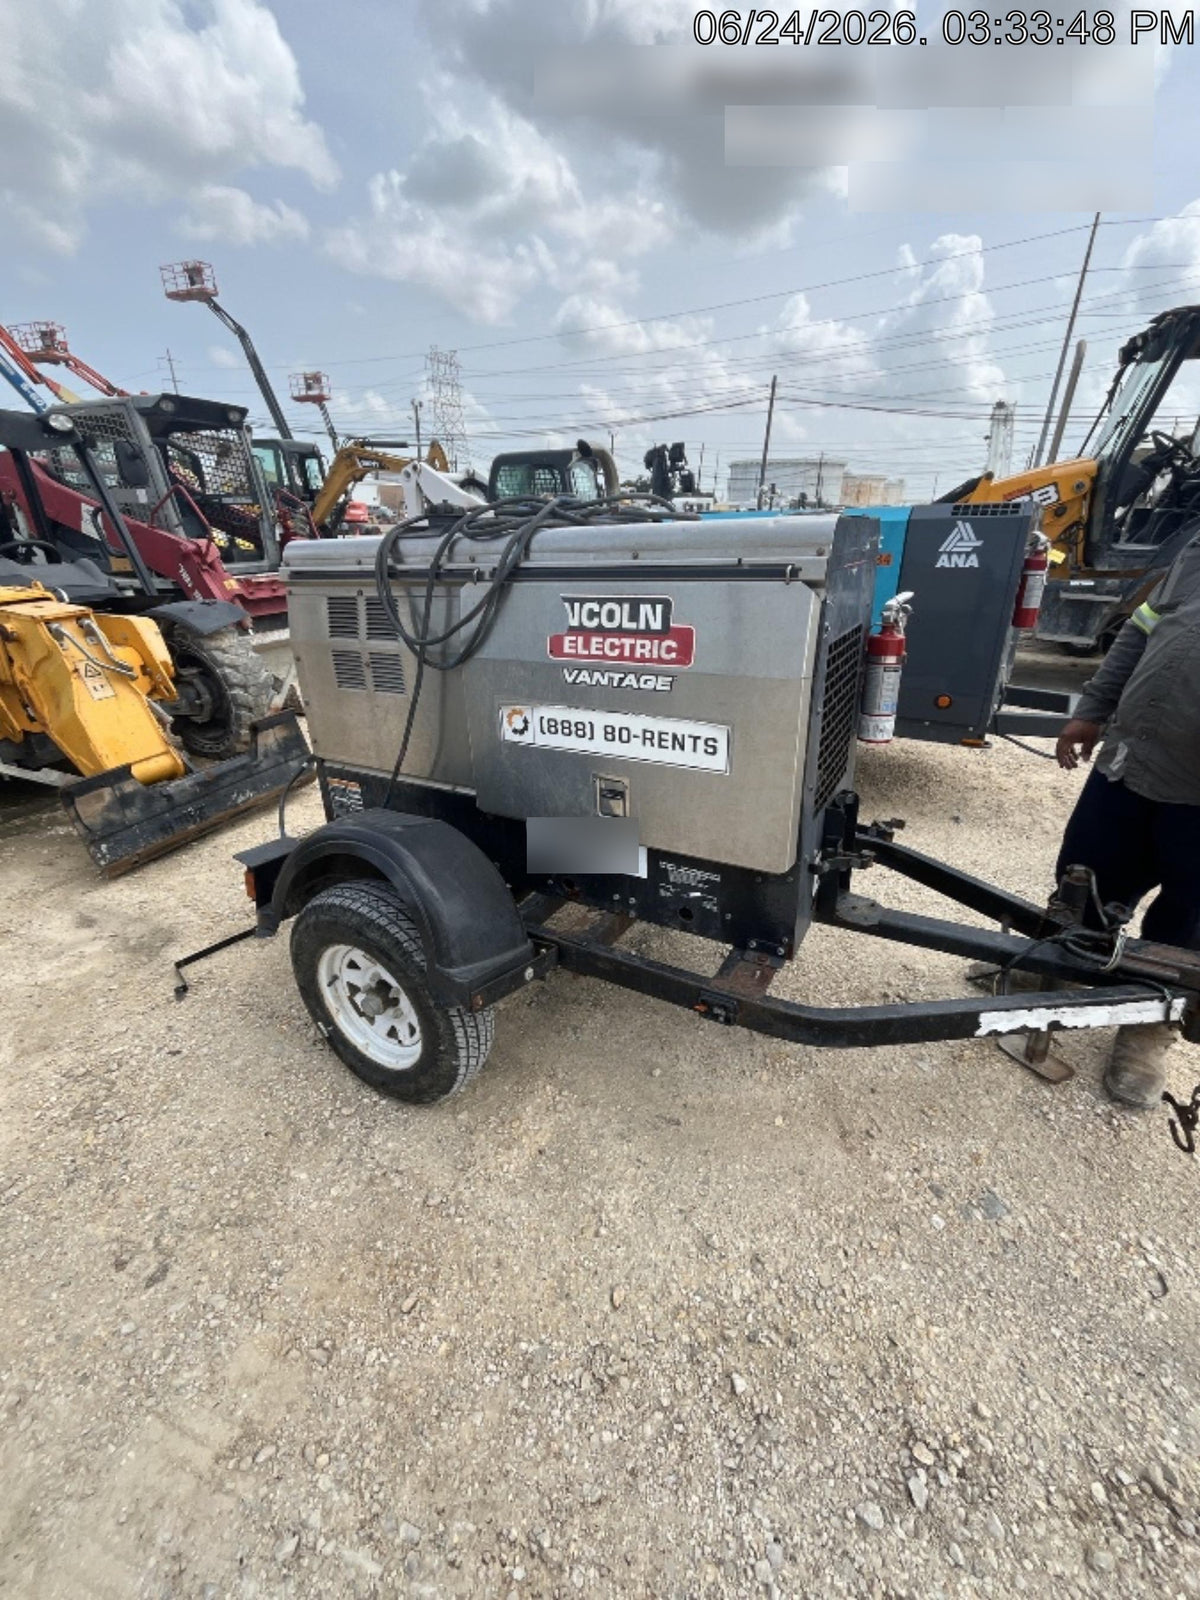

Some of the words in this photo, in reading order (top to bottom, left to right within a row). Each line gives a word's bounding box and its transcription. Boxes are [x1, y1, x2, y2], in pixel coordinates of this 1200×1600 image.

[935, 553, 980, 569] ANA
[562, 635, 678, 660] ELECTRIC
[563, 668, 674, 691] VANTAGE
[539, 716, 594, 740] (888)
[604, 725, 718, 756] 80-RENTS
